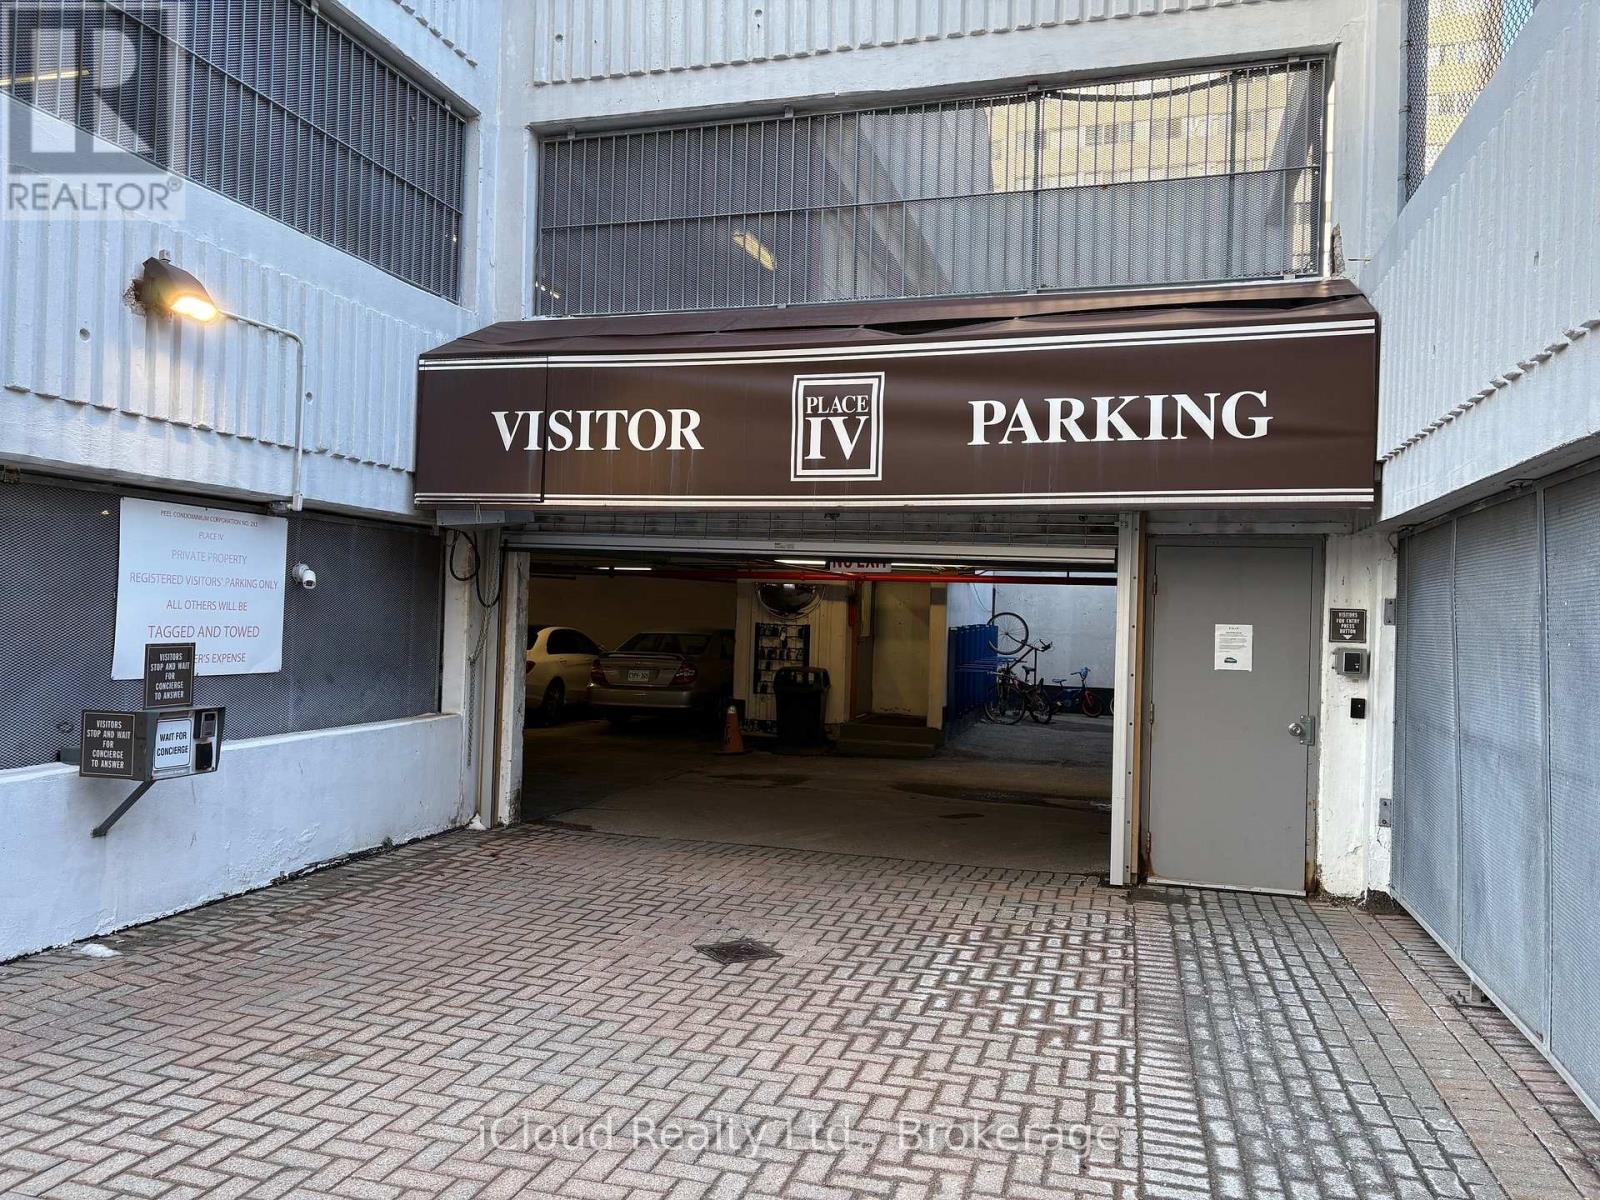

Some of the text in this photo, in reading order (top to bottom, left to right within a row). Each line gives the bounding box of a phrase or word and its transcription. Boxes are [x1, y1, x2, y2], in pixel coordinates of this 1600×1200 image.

[805, 395, 869, 414] PLACE
[967, 390, 1274, 446] PARKING
[491, 408, 704, 452] VISITOR
[804, 415, 870, 460] IV
[171, 549, 248, 565] PRIVATE PROPERTY
[129, 572, 279, 590] REGISTERED VISITORS' PARKING ONLY
[166, 599, 248, 611] ALL OTHERS WILL BE
[148, 625, 260, 639] TAGGED AND TOWED
[159, 652, 183, 662] VISITORS
[211, 652, 246, 664] EXPENSE
[150, 661, 190, 672] STOP AND WAIT
[165, 672, 176, 681] FOR
[155, 681, 184, 691] CONCIERGE
[154, 690, 184, 701] TO ANSWER
[96, 719, 122, 729] VISITORS
[86, 729, 131, 739] STOP AND WAIT
[160, 731, 187, 742] WAIT FOR
[102, 740, 114, 749] FOR
[92, 749, 124, 760] CONCIERGE
[156, 745, 189, 757] CONCIERGE
[91, 759, 125, 769] TO ANSWER
